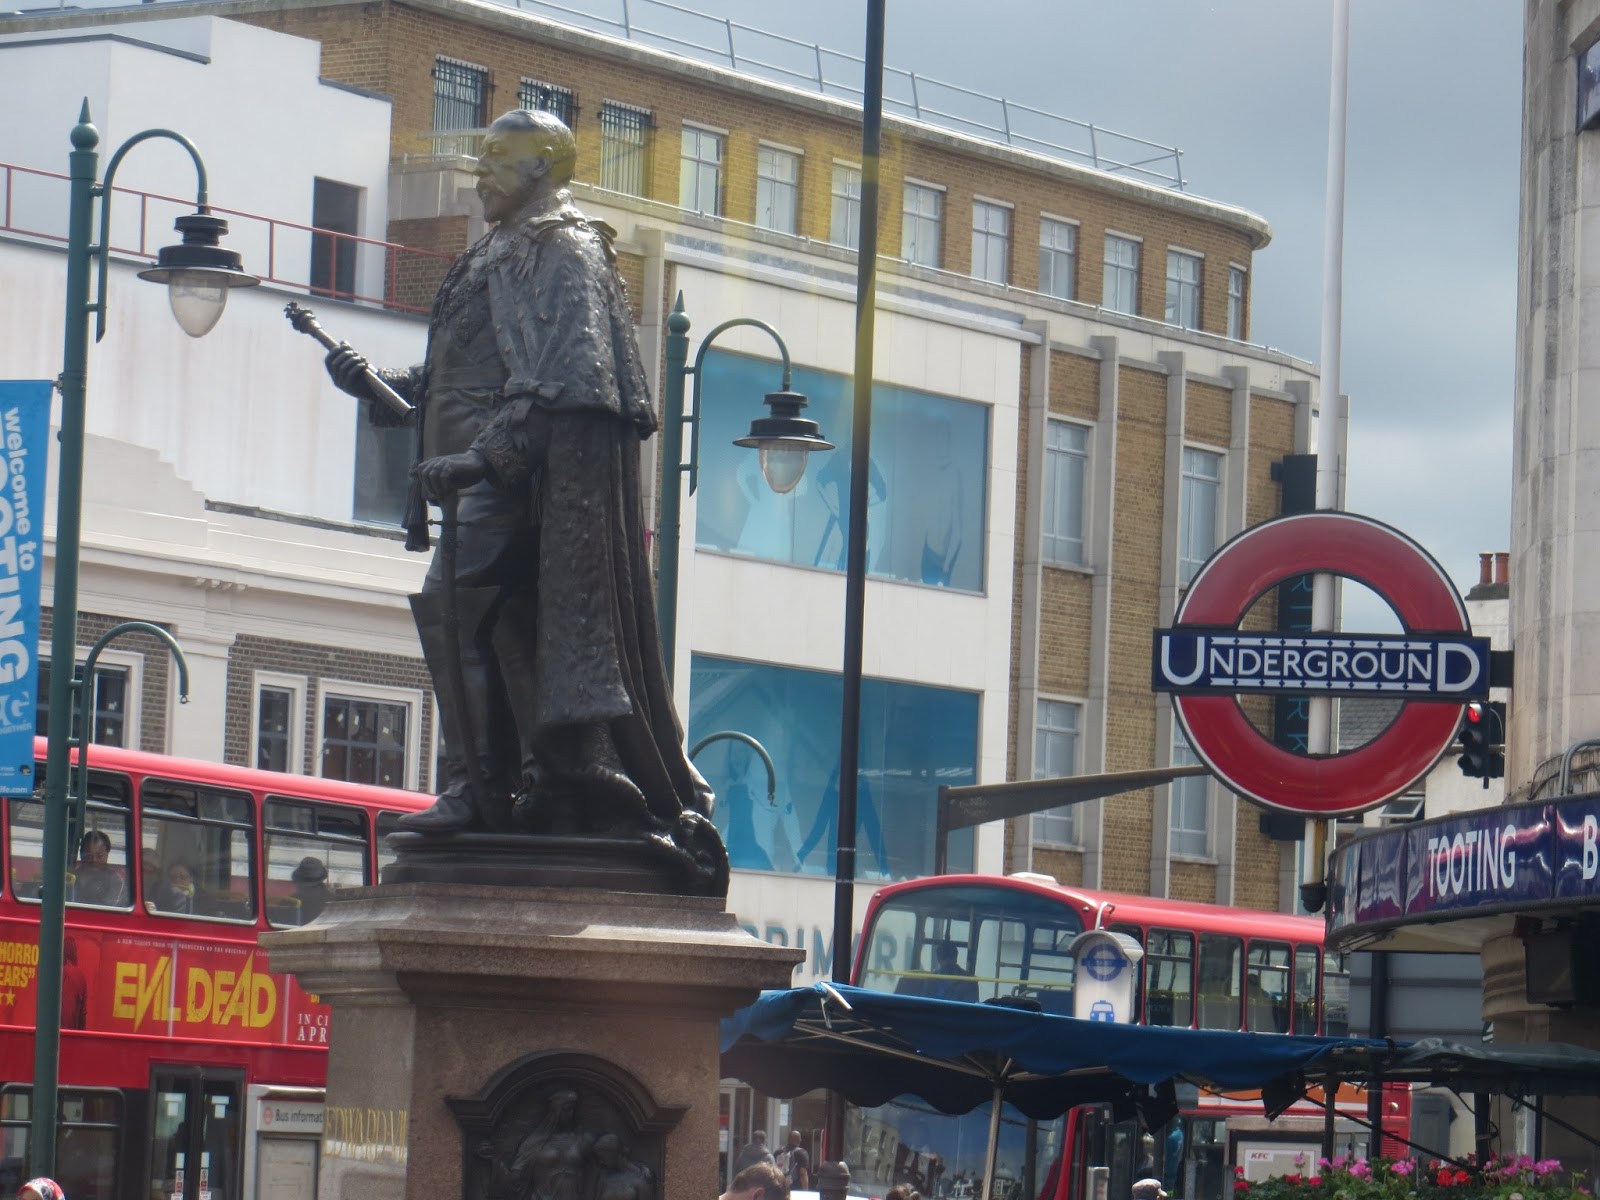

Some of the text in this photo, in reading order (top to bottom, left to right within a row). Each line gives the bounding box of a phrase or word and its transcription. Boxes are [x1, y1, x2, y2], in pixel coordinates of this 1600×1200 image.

[5, 407, 37, 571] welcome to
[1161, 635, 1481, 692] UNDERGROUND
[1428, 814, 1599, 897] TOOTING B
[113, 950, 277, 1033] EVIL DEAD
[298, 1013, 311, 1025] IN
[275, 1108, 288, 1122] Bus
[1250, 1152, 1269, 1160] KFC
